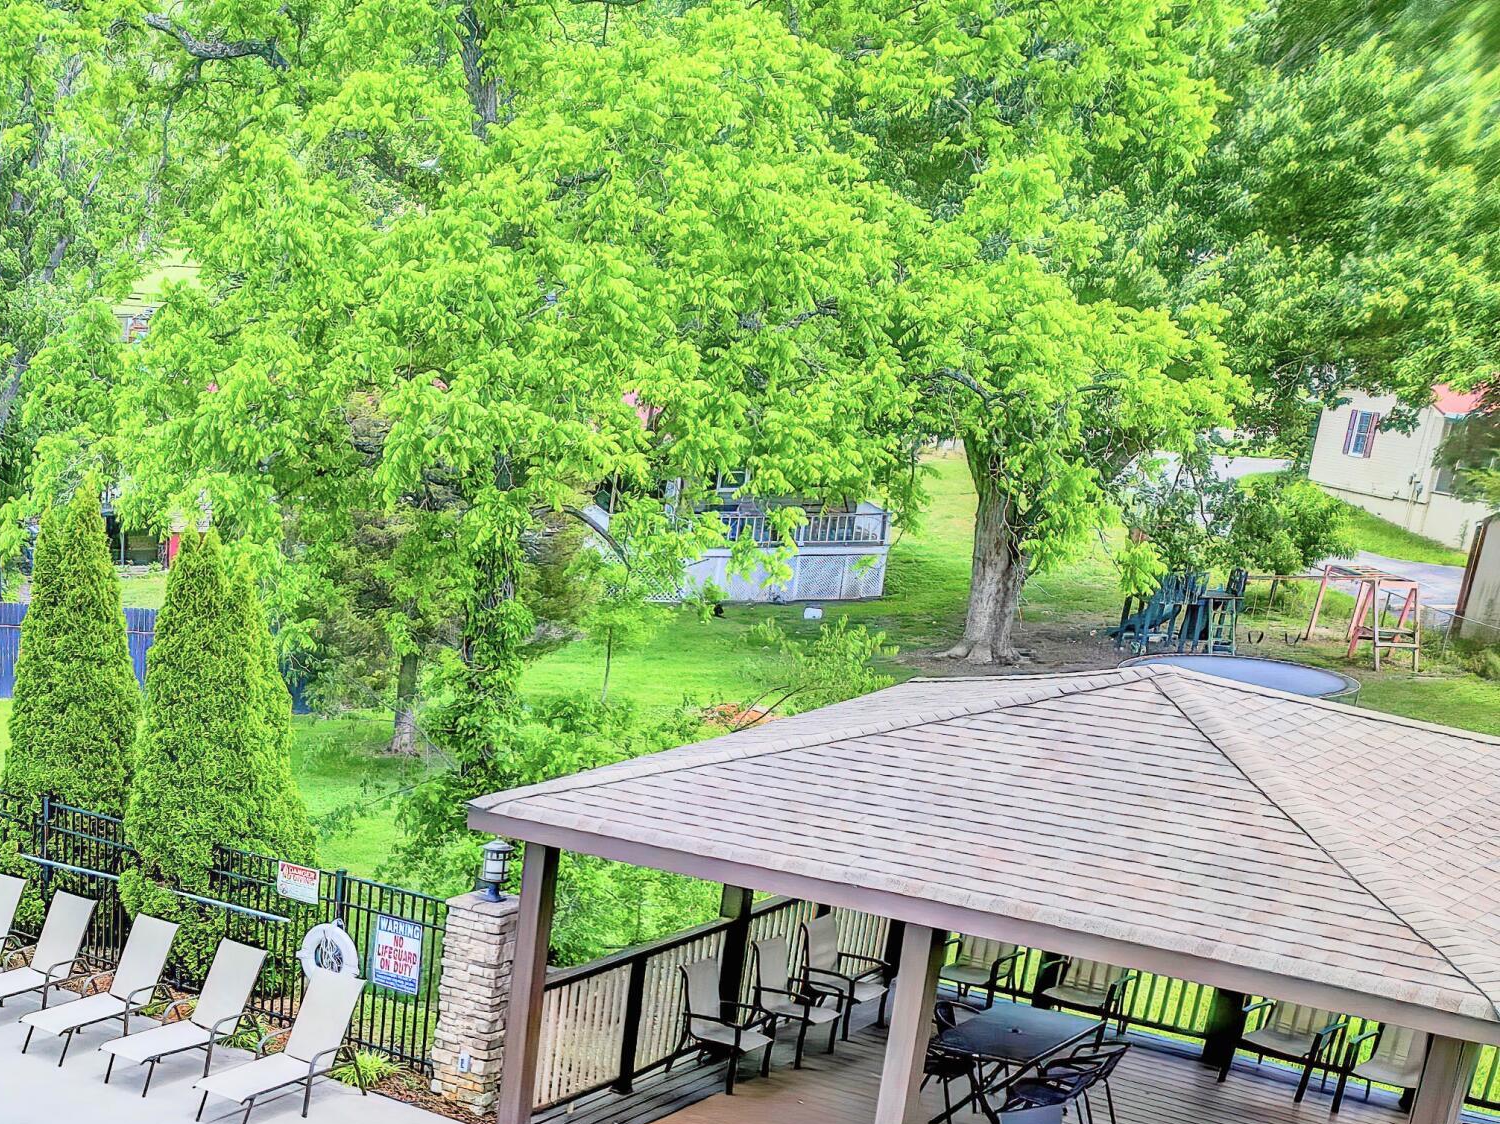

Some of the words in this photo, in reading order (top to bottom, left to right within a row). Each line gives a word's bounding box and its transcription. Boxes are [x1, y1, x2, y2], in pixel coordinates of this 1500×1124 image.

[380, 917, 421, 939] WARNING
[393, 935, 404, 949] NO
[377, 943, 418, 965] LIFEGUARD
[380, 957, 390, 971] ON
[393, 961, 412, 976] DUTY
